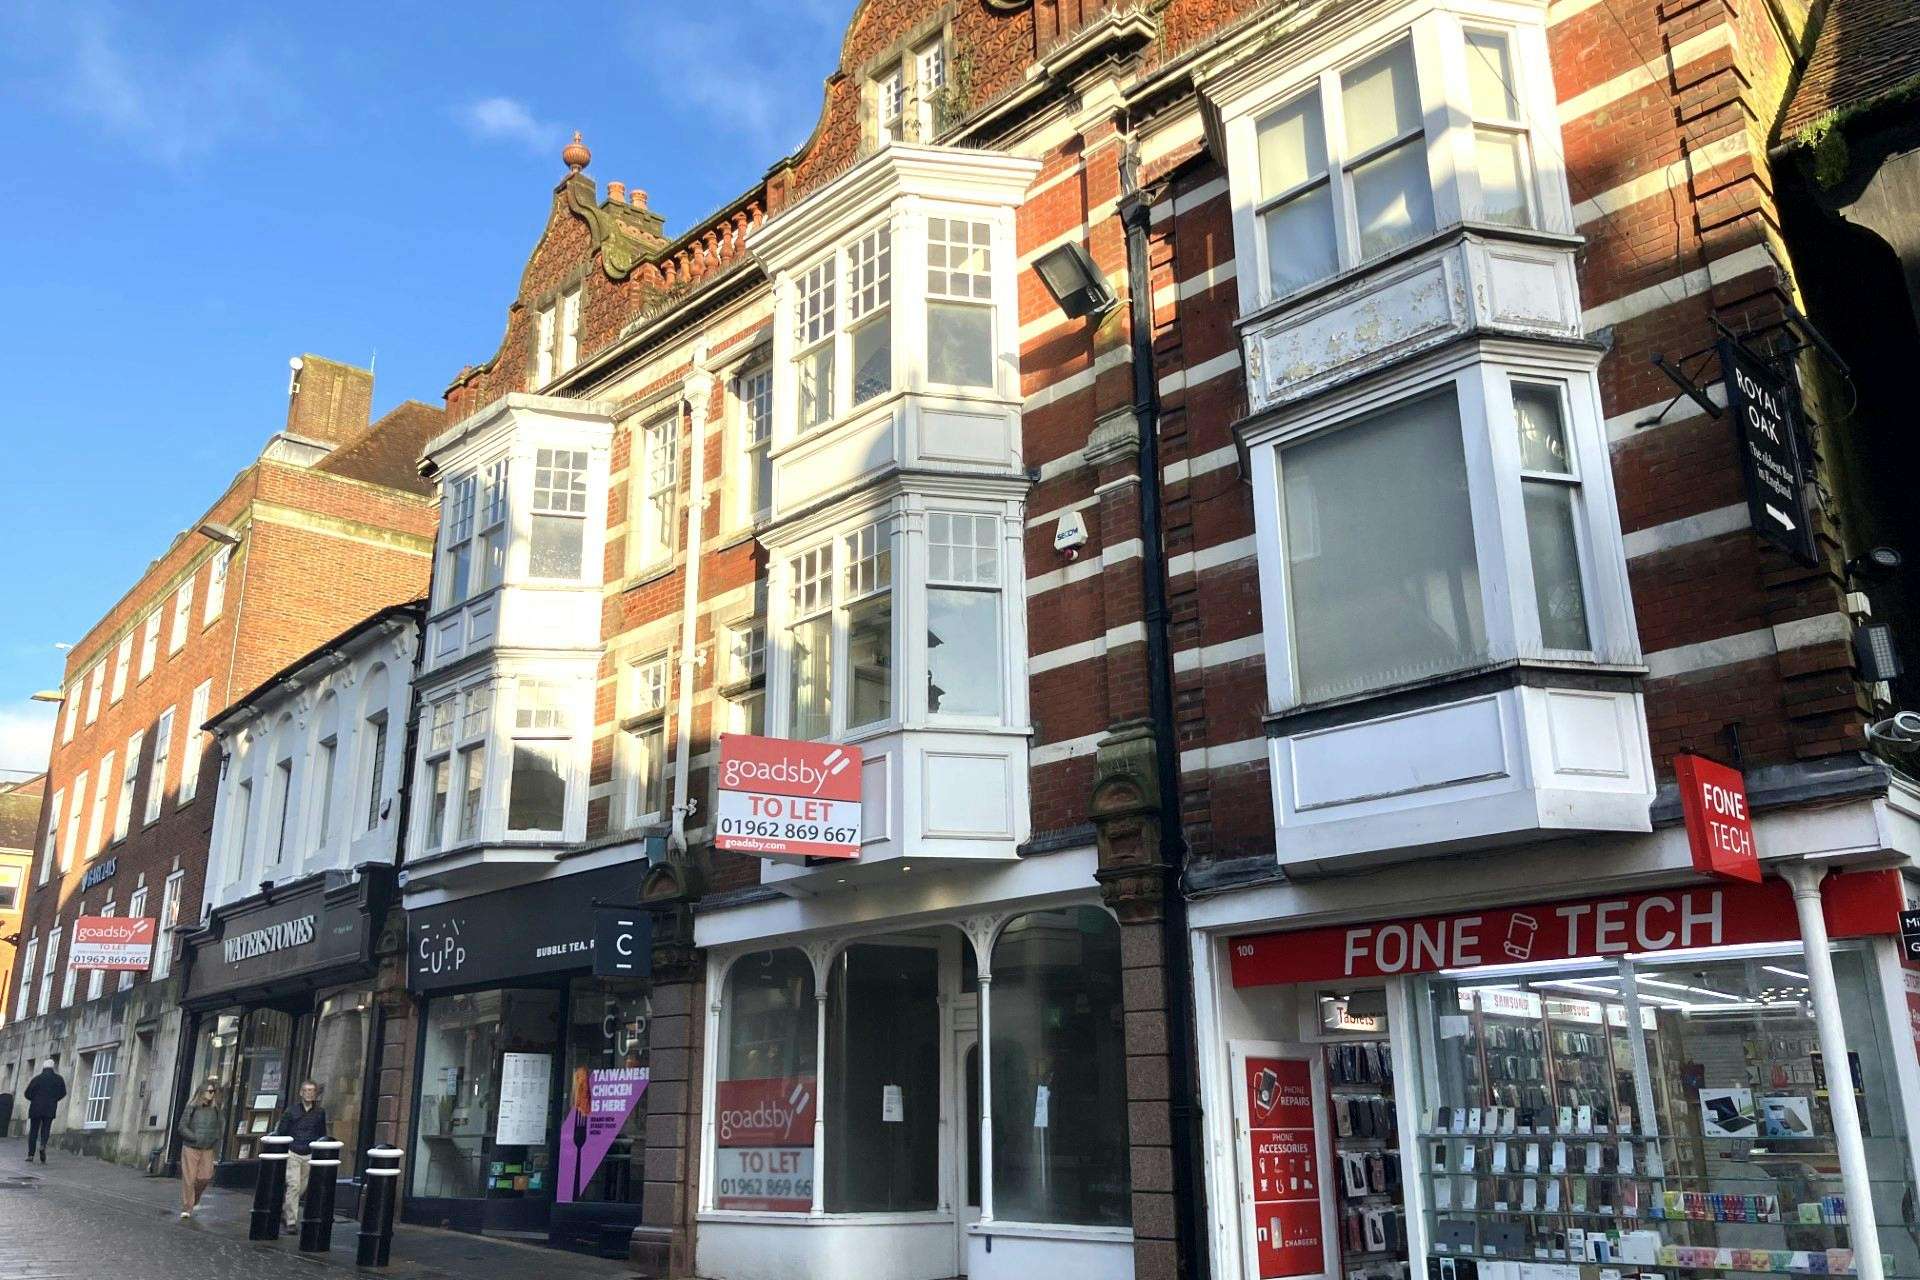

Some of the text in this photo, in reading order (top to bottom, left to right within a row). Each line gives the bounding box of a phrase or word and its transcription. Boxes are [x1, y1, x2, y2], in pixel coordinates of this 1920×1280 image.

[1736, 367, 1781, 420] ROYAL
[1749, 405, 1780, 445] OAK
[1749, 441, 1762, 461] The
[1757, 463, 1792, 500] in England
[724, 757, 828, 795] goadsby
[748, 796, 834, 822] TO LET
[1703, 783, 1745, 821] FONE
[721, 818, 857, 843] 01962 869 667
[1710, 821, 1751, 857] TECH
[725, 838, 786, 851] goadsby.com
[78, 925, 136, 942] goadsby
[223, 915, 314, 963] WATERSTONES
[1344, 891, 1723, 976] FONE TECH
[536, 944, 568, 958] BUBBLE
[569, 941, 588, 952] TEA.
[616, 934, 633, 956] C
[1237, 945, 1254, 957] 100
[73, 955, 148, 965] 01962 869 667
[420, 937, 466, 974] CUPP
[1494, 994, 1529, 1011] SAMSUNG
[1560, 1002, 1590, 1017] SAMSUNG
[592, 1083, 633, 1097] CHICKEN
[1284, 1086, 1305, 1095] PHONE
[591, 1099, 626, 1112] IS HERE
[1280, 1096, 1310, 1106] REPAIRS
[721, 1101, 794, 1140] goadsby
[1272, 1133, 1294, 1142] PHONE
[1259, 1143, 1308, 1154] ACCESSORIES
[739, 1152, 801, 1173] TO LET
[721, 1179, 763, 1195] 01962
[767, 1179, 792, 1195] 869
[1285, 1238, 1317, 1248] CHARGERS
